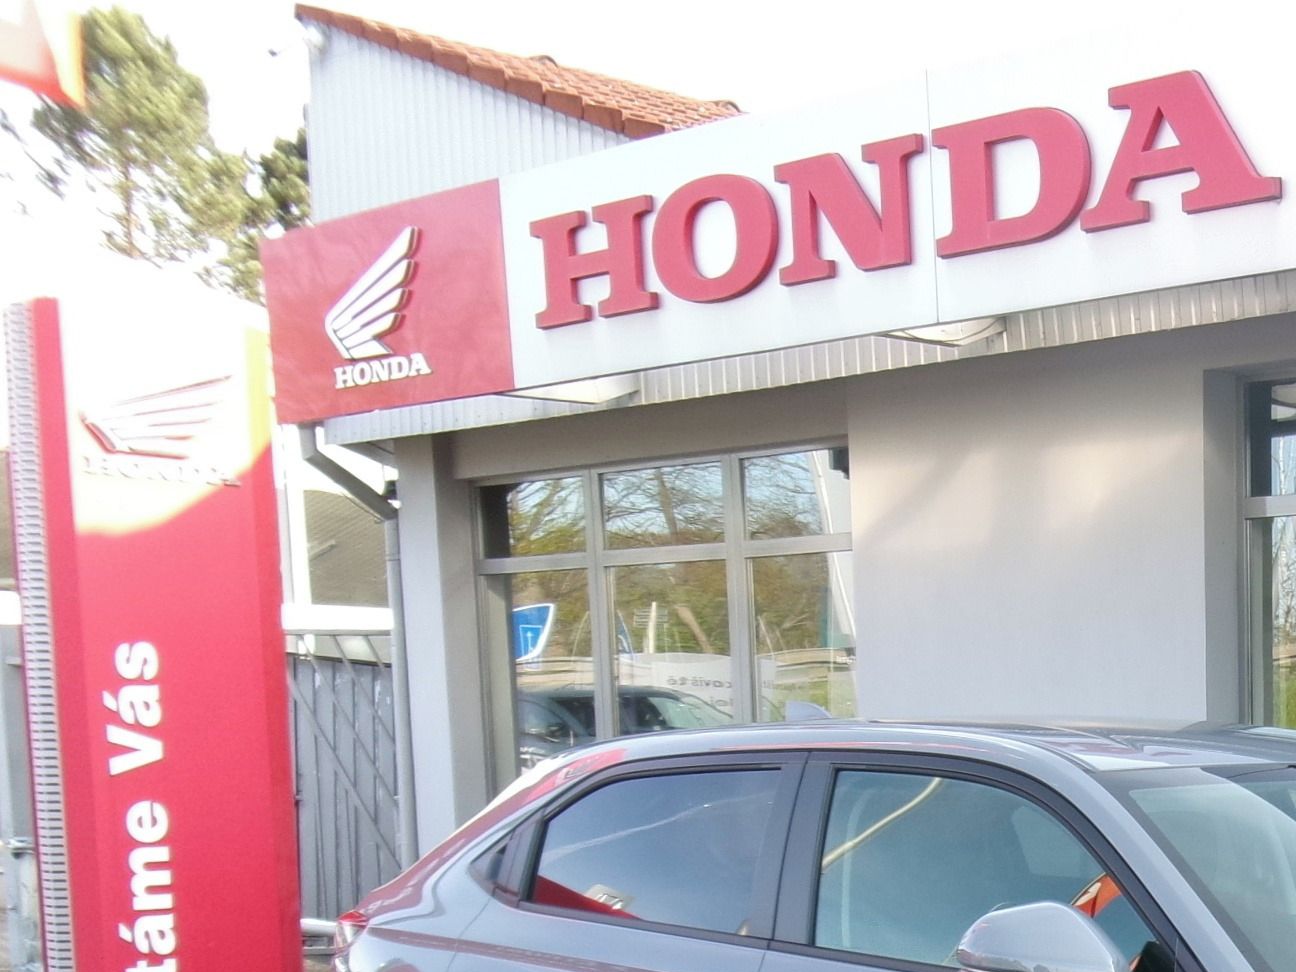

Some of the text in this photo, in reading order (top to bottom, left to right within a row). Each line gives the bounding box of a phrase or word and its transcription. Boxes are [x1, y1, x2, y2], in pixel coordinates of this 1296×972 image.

[528, 69, 1283, 331] HONDA
[333, 352, 432, 390] HONDA
[102, 641, 165, 776] Vás
